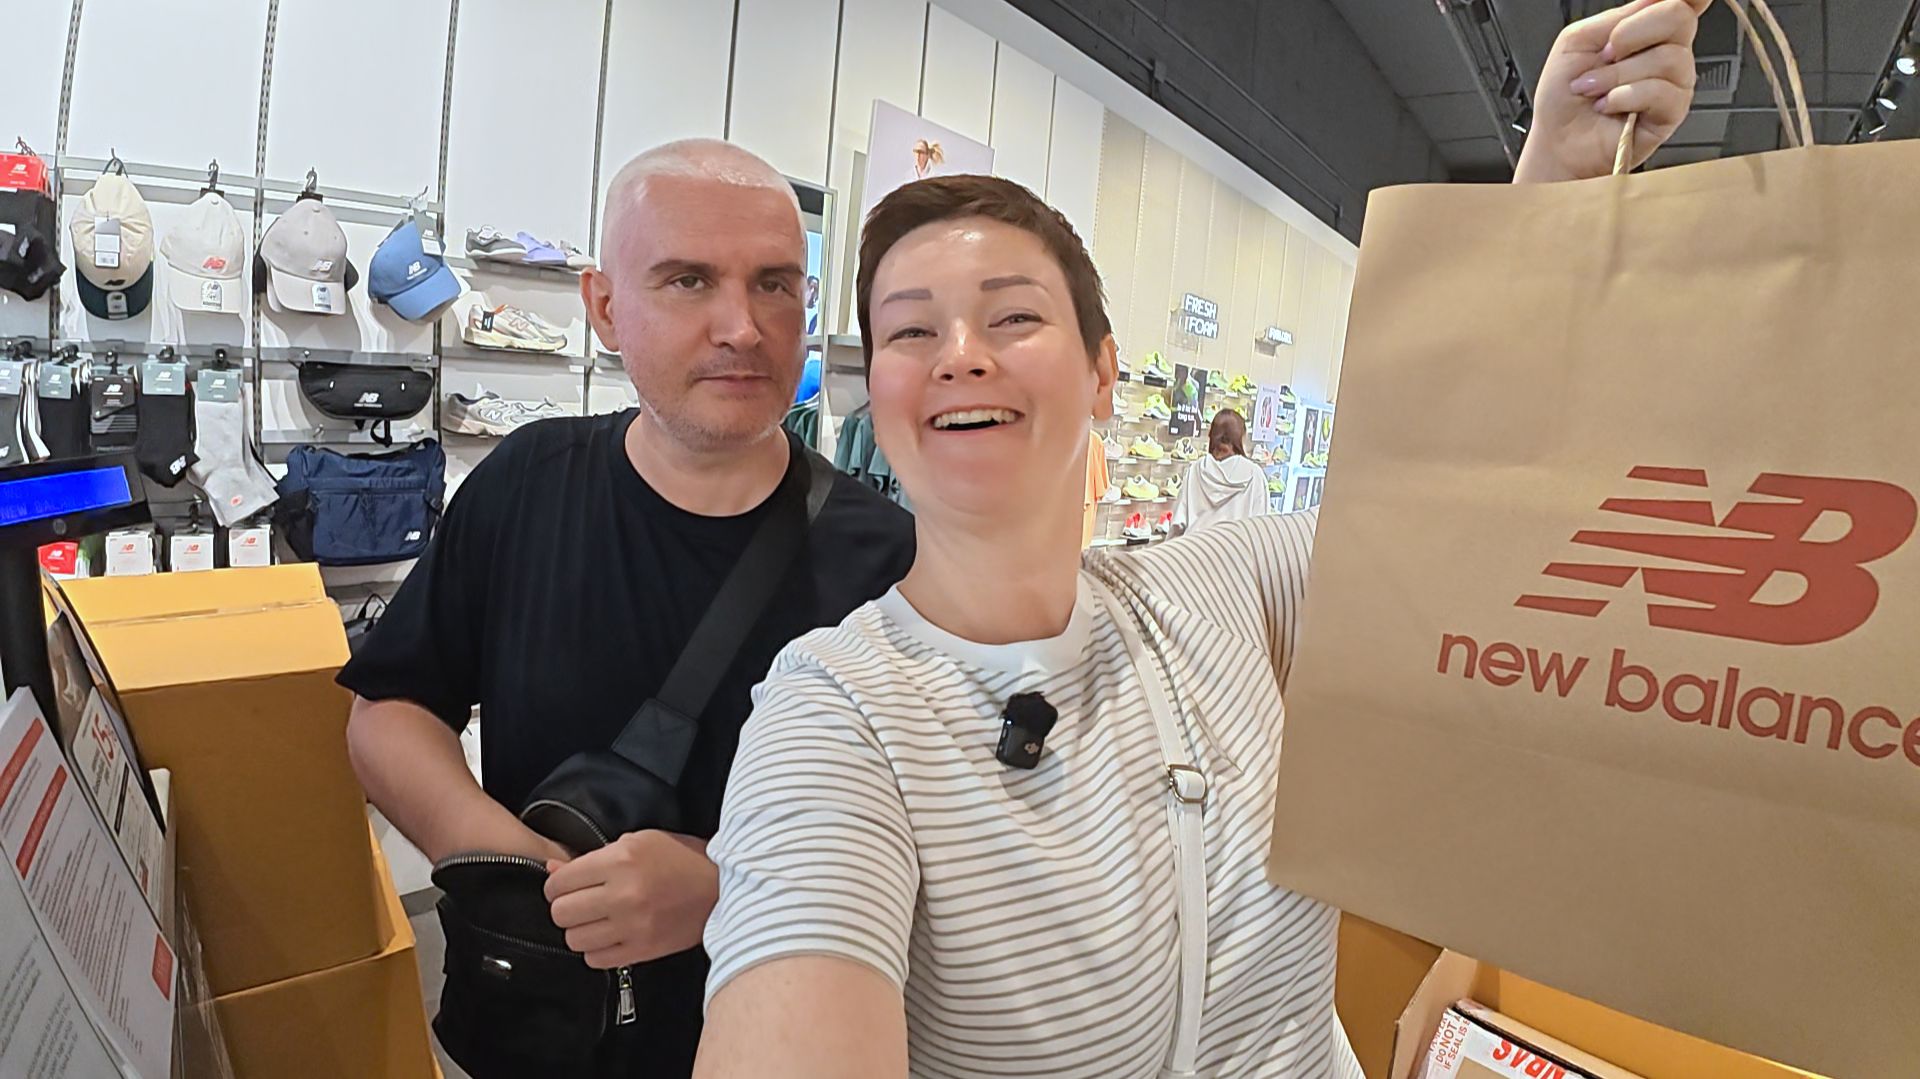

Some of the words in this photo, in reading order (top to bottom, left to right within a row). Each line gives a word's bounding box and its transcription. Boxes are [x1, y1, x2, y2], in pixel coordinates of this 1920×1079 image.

[311, 260, 333, 271] NB
[1185, 294, 1217, 320] FRESH
[1189, 316, 1218, 339] FOAM
[358, 391, 380, 403] NB
[404, 530, 421, 541] NB
[1514, 466, 1918, 646] NB
[1437, 633, 1590, 698] new
[1440, 1021, 1457, 1049] NOT
[1436, 1049, 1447, 1063] DO
[1443, 1060, 1452, 1070] IF
[1448, 1038, 1464, 1060] SEAL
[1458, 1025, 1468, 1037] IS
